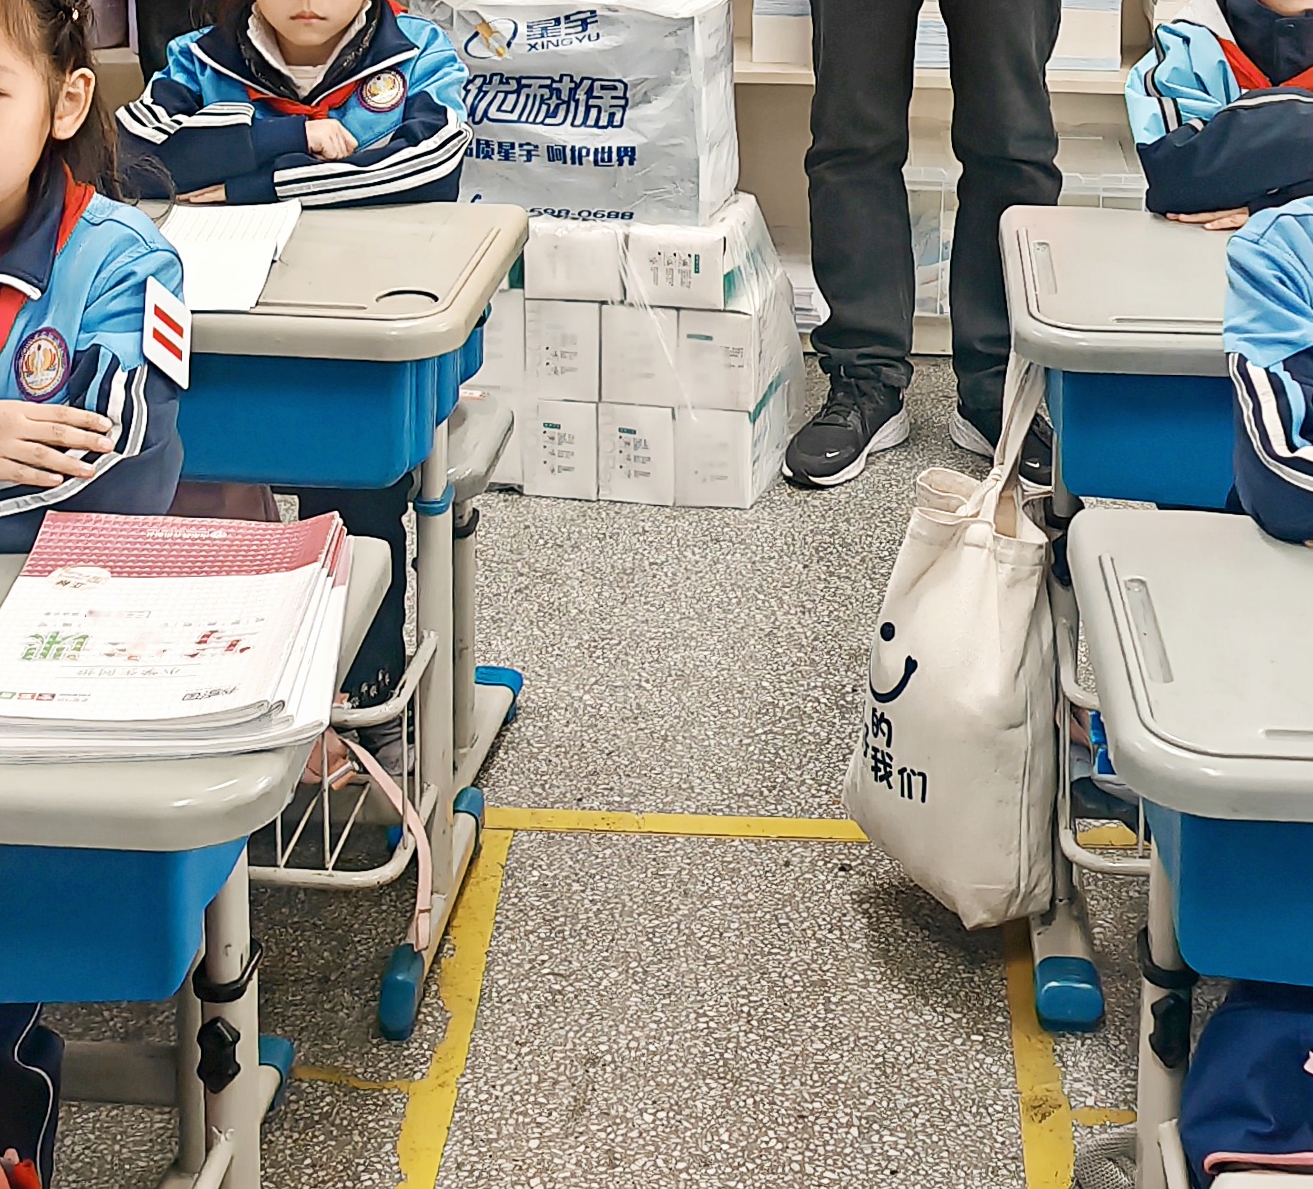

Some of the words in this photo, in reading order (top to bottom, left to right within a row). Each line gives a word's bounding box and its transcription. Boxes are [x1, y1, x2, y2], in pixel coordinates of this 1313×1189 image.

[526, 9, 599, 41] 星宇
[527, 31, 601, 53] XINGYU
[546, 144, 638, 168] 呵护世界
